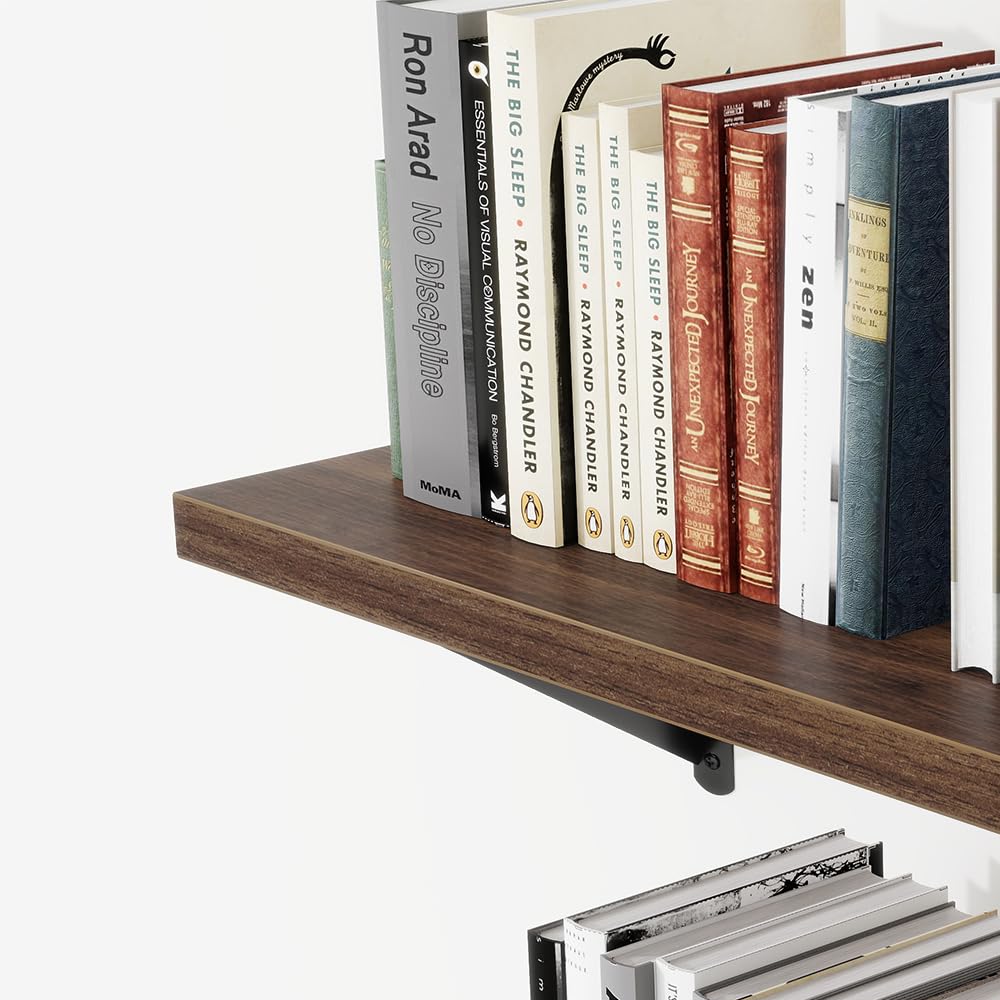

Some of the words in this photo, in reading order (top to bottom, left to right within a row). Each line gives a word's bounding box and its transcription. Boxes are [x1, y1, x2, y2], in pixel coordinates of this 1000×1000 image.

[402, 32, 432, 95] Ron
[506, 49, 521, 89] THE
[568, 73, 593, 111] Marlowe
[592, 51, 623, 75] mystery
[406, 105, 438, 181] Arad
[474, 100, 489, 191] ESSENTIALS
[508, 98, 522, 137] BIG
[510, 147, 526, 208] SLEEP
[574, 144, 586, 176] THE
[609, 136, 618, 168] THE
[411, 202, 442, 245] No
[478, 194, 491, 216] OF
[576, 184, 587, 216] BIG
[611, 178, 620, 210] BIG
[646, 182, 658, 213] THE
[480, 218, 493, 270] VISUAL
[578, 224, 589, 273] SLEEP
[612, 219, 622, 270] SLEEP
[648, 220, 660, 250] BIG
[514, 239, 531, 351] RAYMOND
[649, 258, 661, 306] SLEEP
[682, 242, 709, 325] JOURNEY
[801, 265, 815, 330] zen
[413, 254, 448, 398] Discipline
[482, 274, 498, 402] COMMUNICATION
[580, 299, 594, 392] RAYMOND
[614, 298, 626, 395] RAYMOND
[740, 282, 758, 392] UNEXPECTED
[651, 330, 665, 420] RAYMOND
[685, 322, 705, 437] UNEXPECTED
[520, 361, 537, 474] CHANDLER
[584, 400, 598, 493] CHANDLER
[690, 437, 699, 452] AN
[739, 388, 760, 466] JOURNEY
[618, 403, 630, 500] CHANDLER
[654, 427, 668, 516] CHANDLER
[420, 479, 462, 500] MoMA
